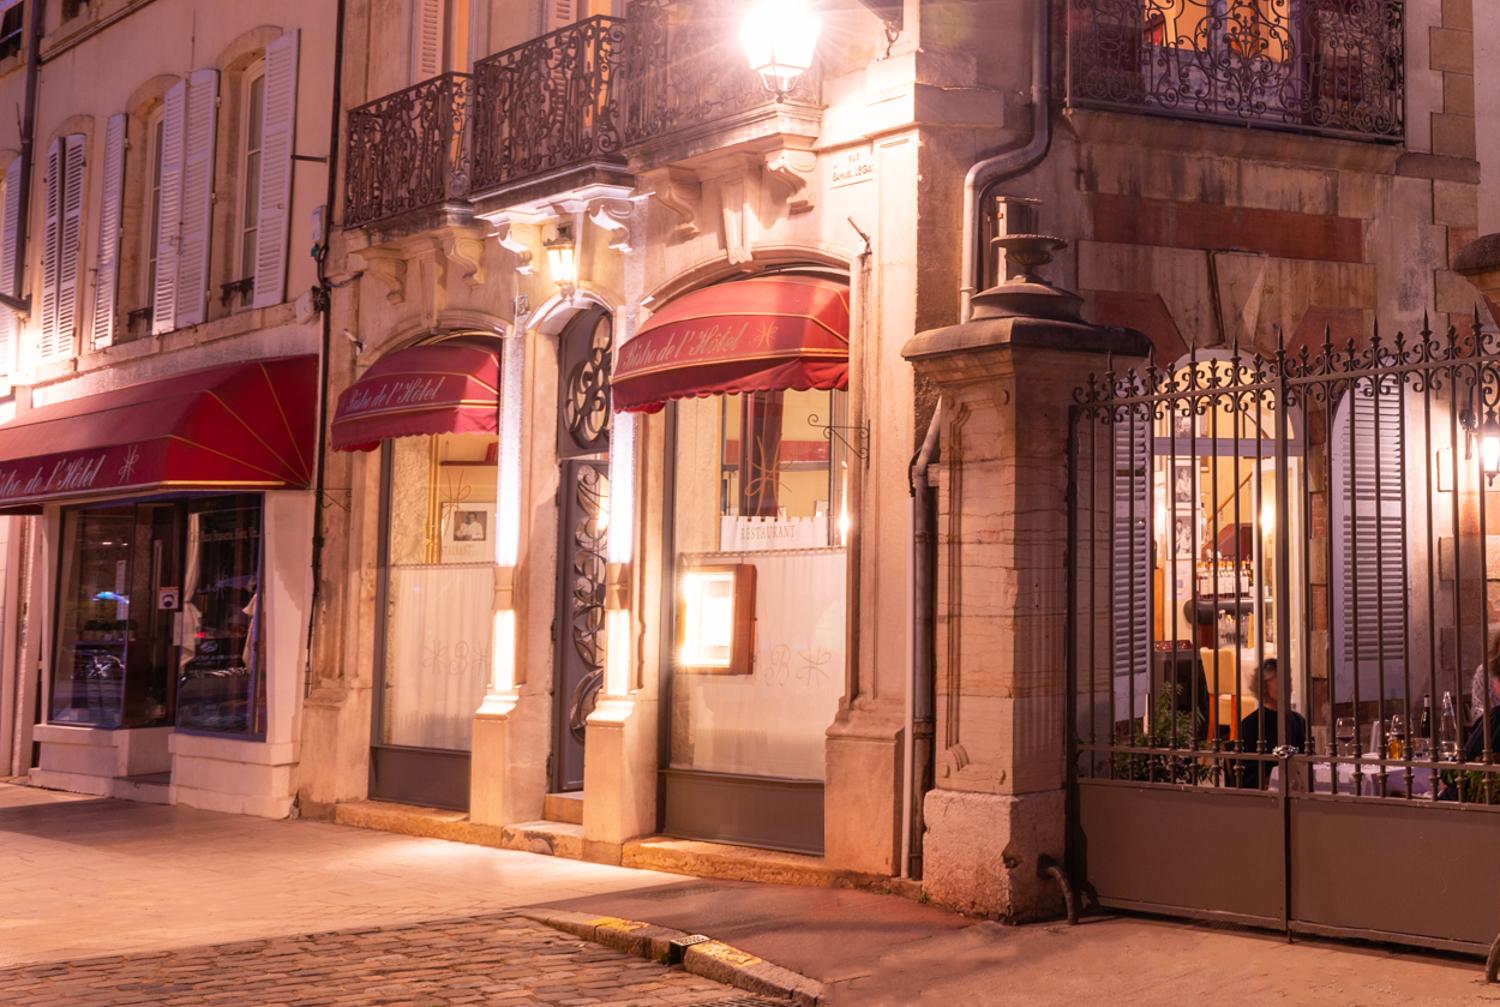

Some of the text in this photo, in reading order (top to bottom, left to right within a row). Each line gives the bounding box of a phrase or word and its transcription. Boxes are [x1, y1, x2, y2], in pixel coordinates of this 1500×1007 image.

[657, 332, 674, 361] de
[24, 467, 43, 493] de
[741, 525, 796, 541] RESTAURANT
